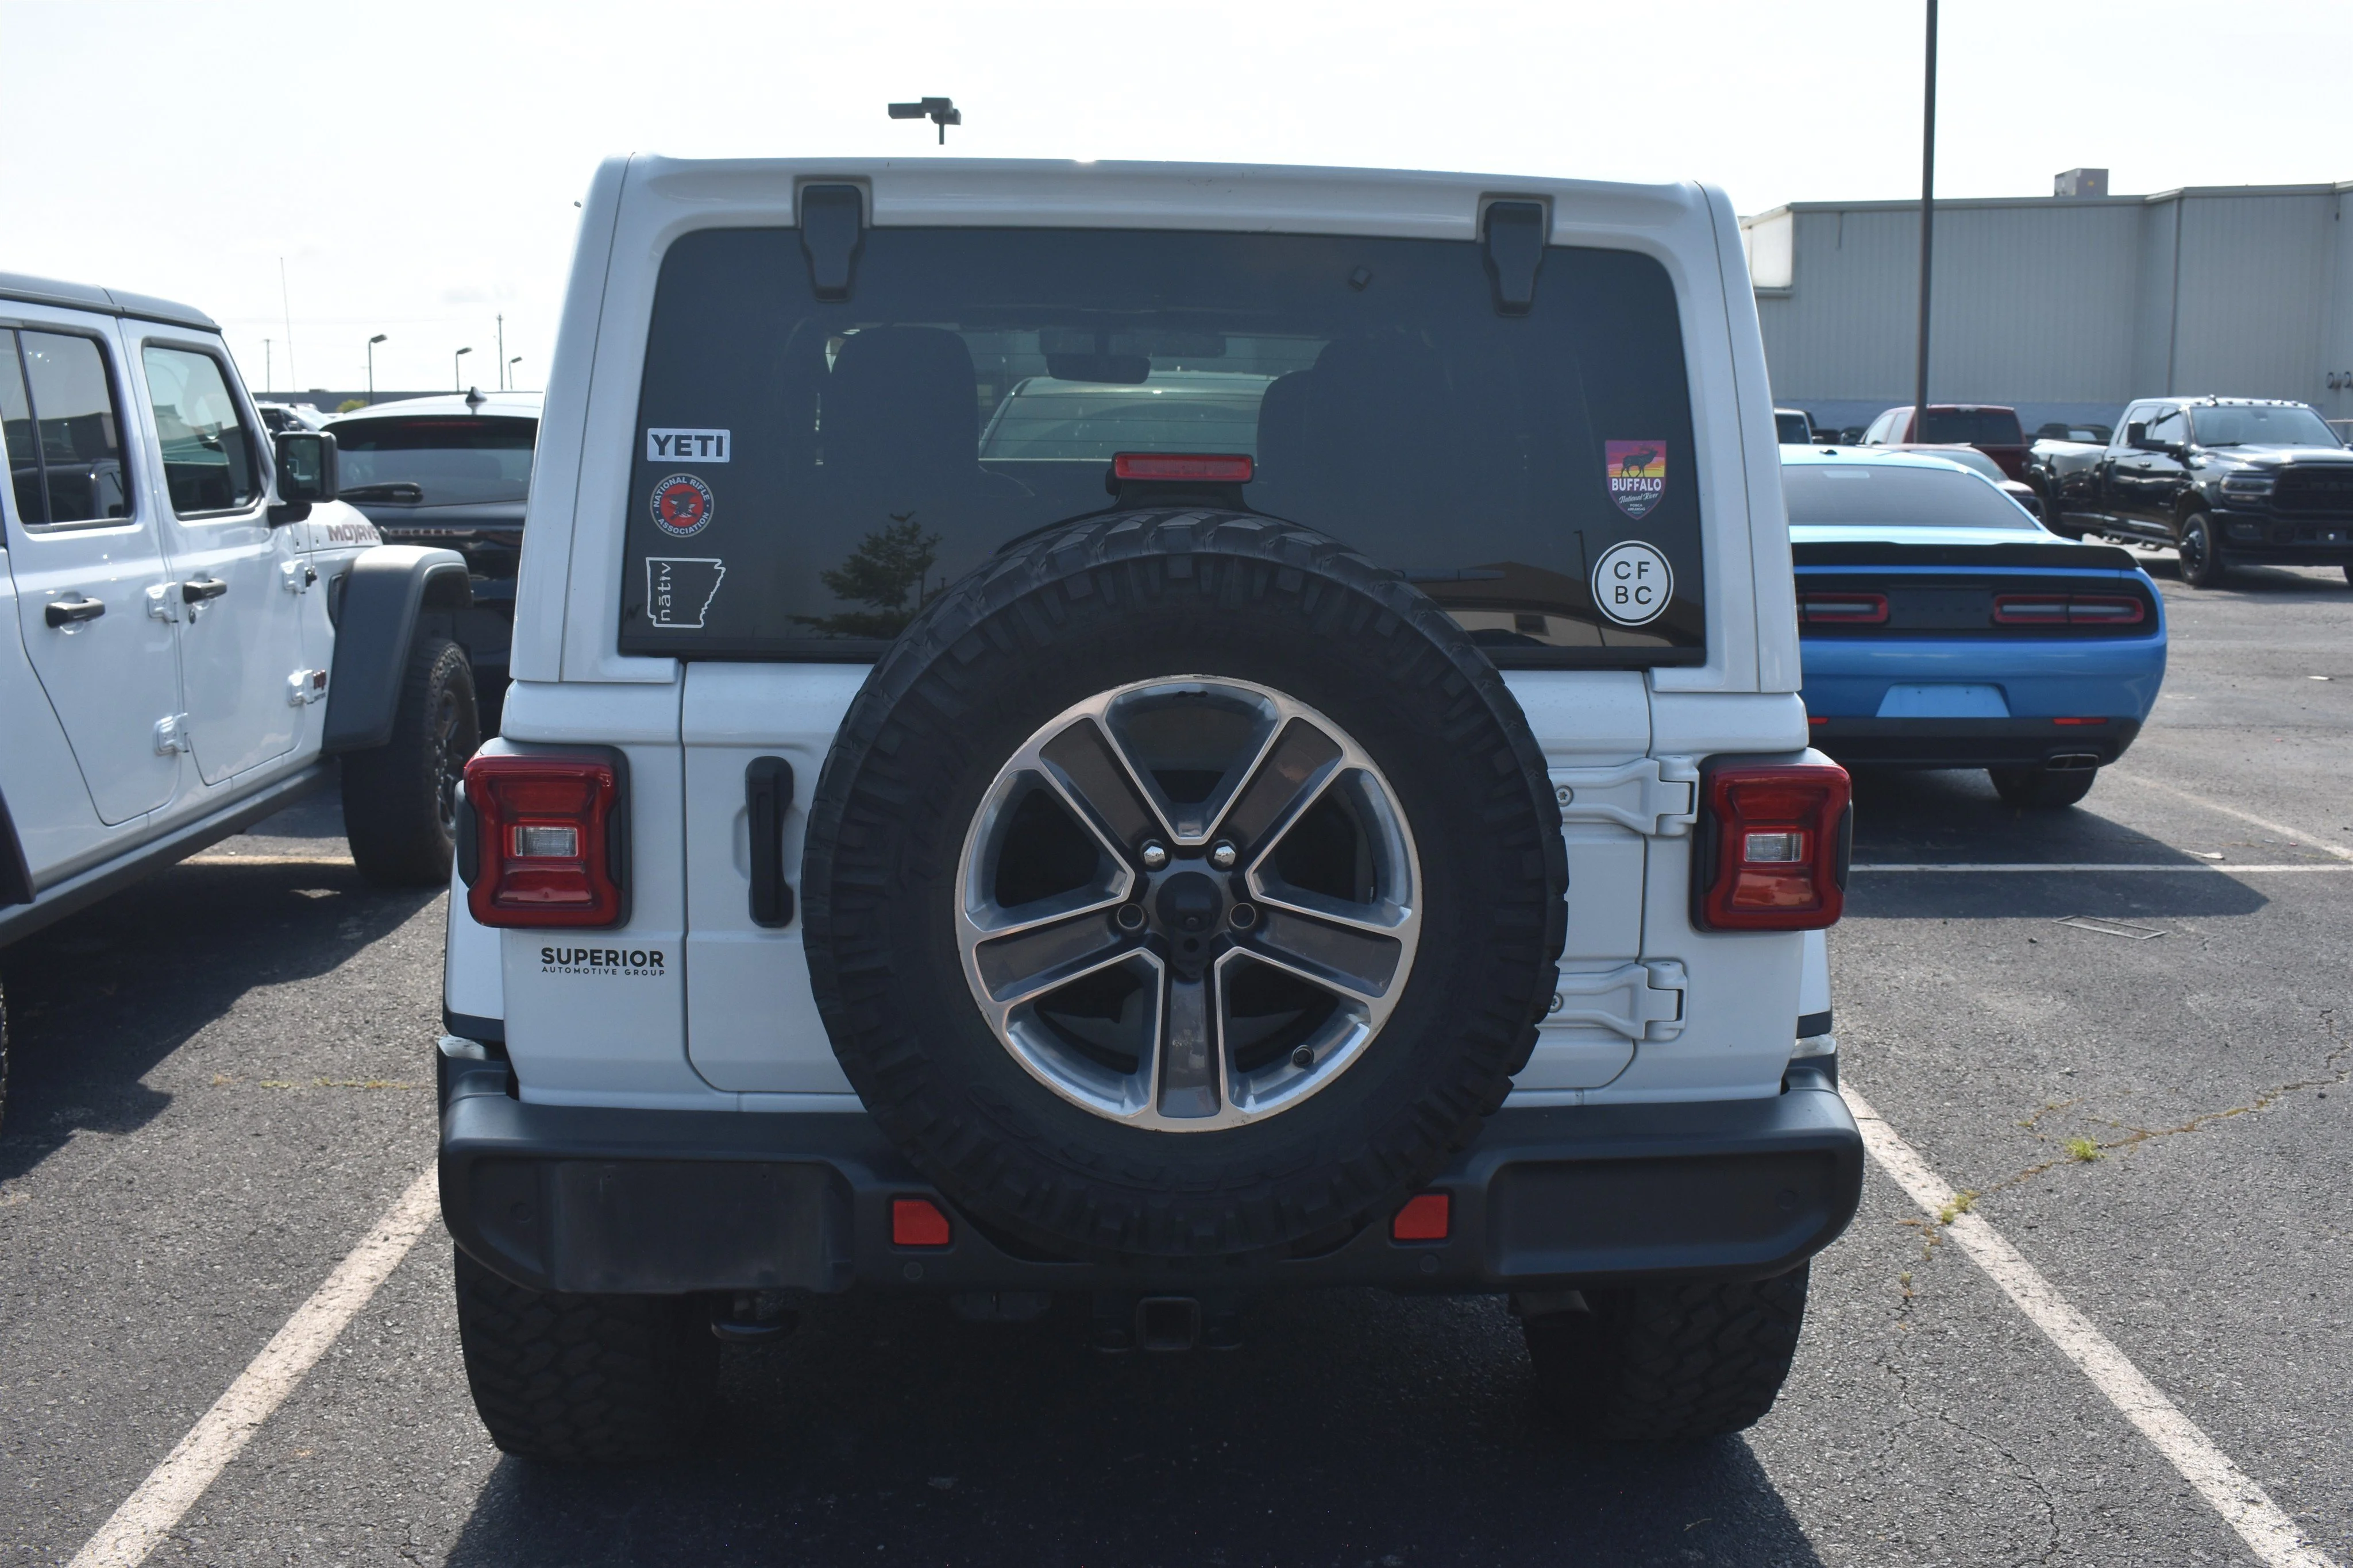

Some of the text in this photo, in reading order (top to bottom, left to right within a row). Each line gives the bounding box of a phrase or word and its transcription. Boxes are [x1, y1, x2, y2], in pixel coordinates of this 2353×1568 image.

[651, 434, 723, 457] YETI
[653, 477, 711, 508] NATIONAL RIFLE
[1612, 478, 1661, 491] BUFFALO
[1619, 492, 1659, 504] National River
[658, 512, 709, 535] ASSOCIATION
[541, 947, 664, 967] SUPERIOR
[542, 966, 665, 976] AUTOMOTIVE GROUP
